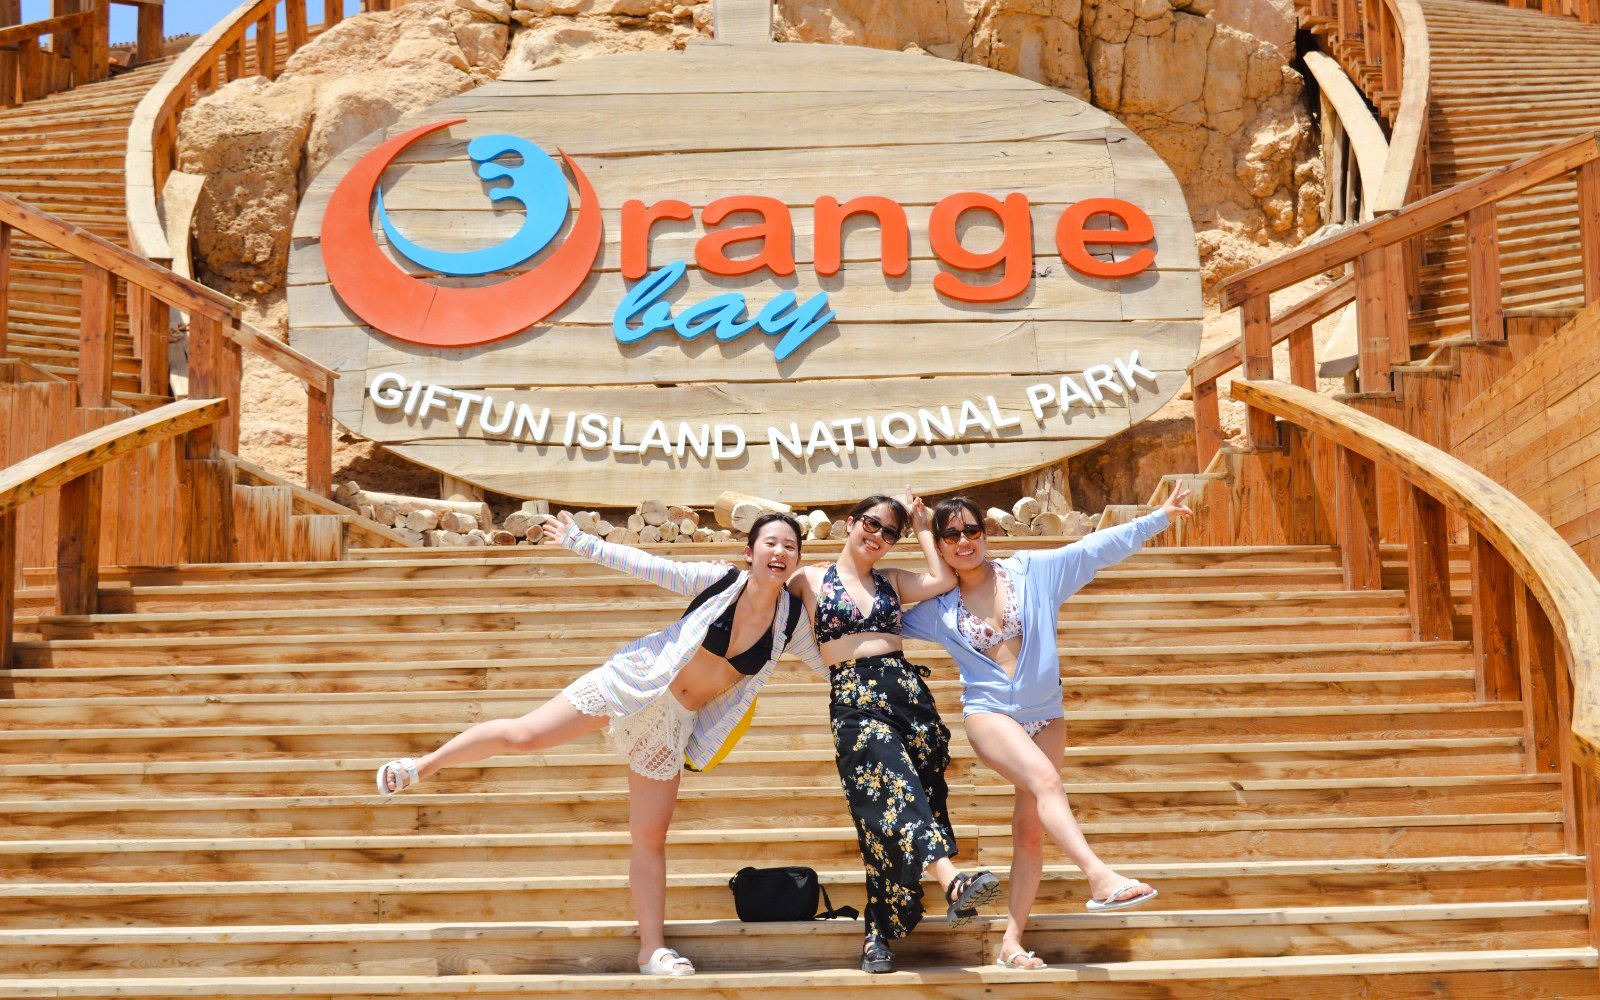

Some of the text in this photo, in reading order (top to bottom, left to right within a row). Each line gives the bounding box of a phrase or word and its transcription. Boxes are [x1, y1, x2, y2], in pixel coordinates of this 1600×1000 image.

[613, 260, 835, 361] bay
[368, 349, 1158, 463] GIFTUN ISLAND NATIONAL PARK
